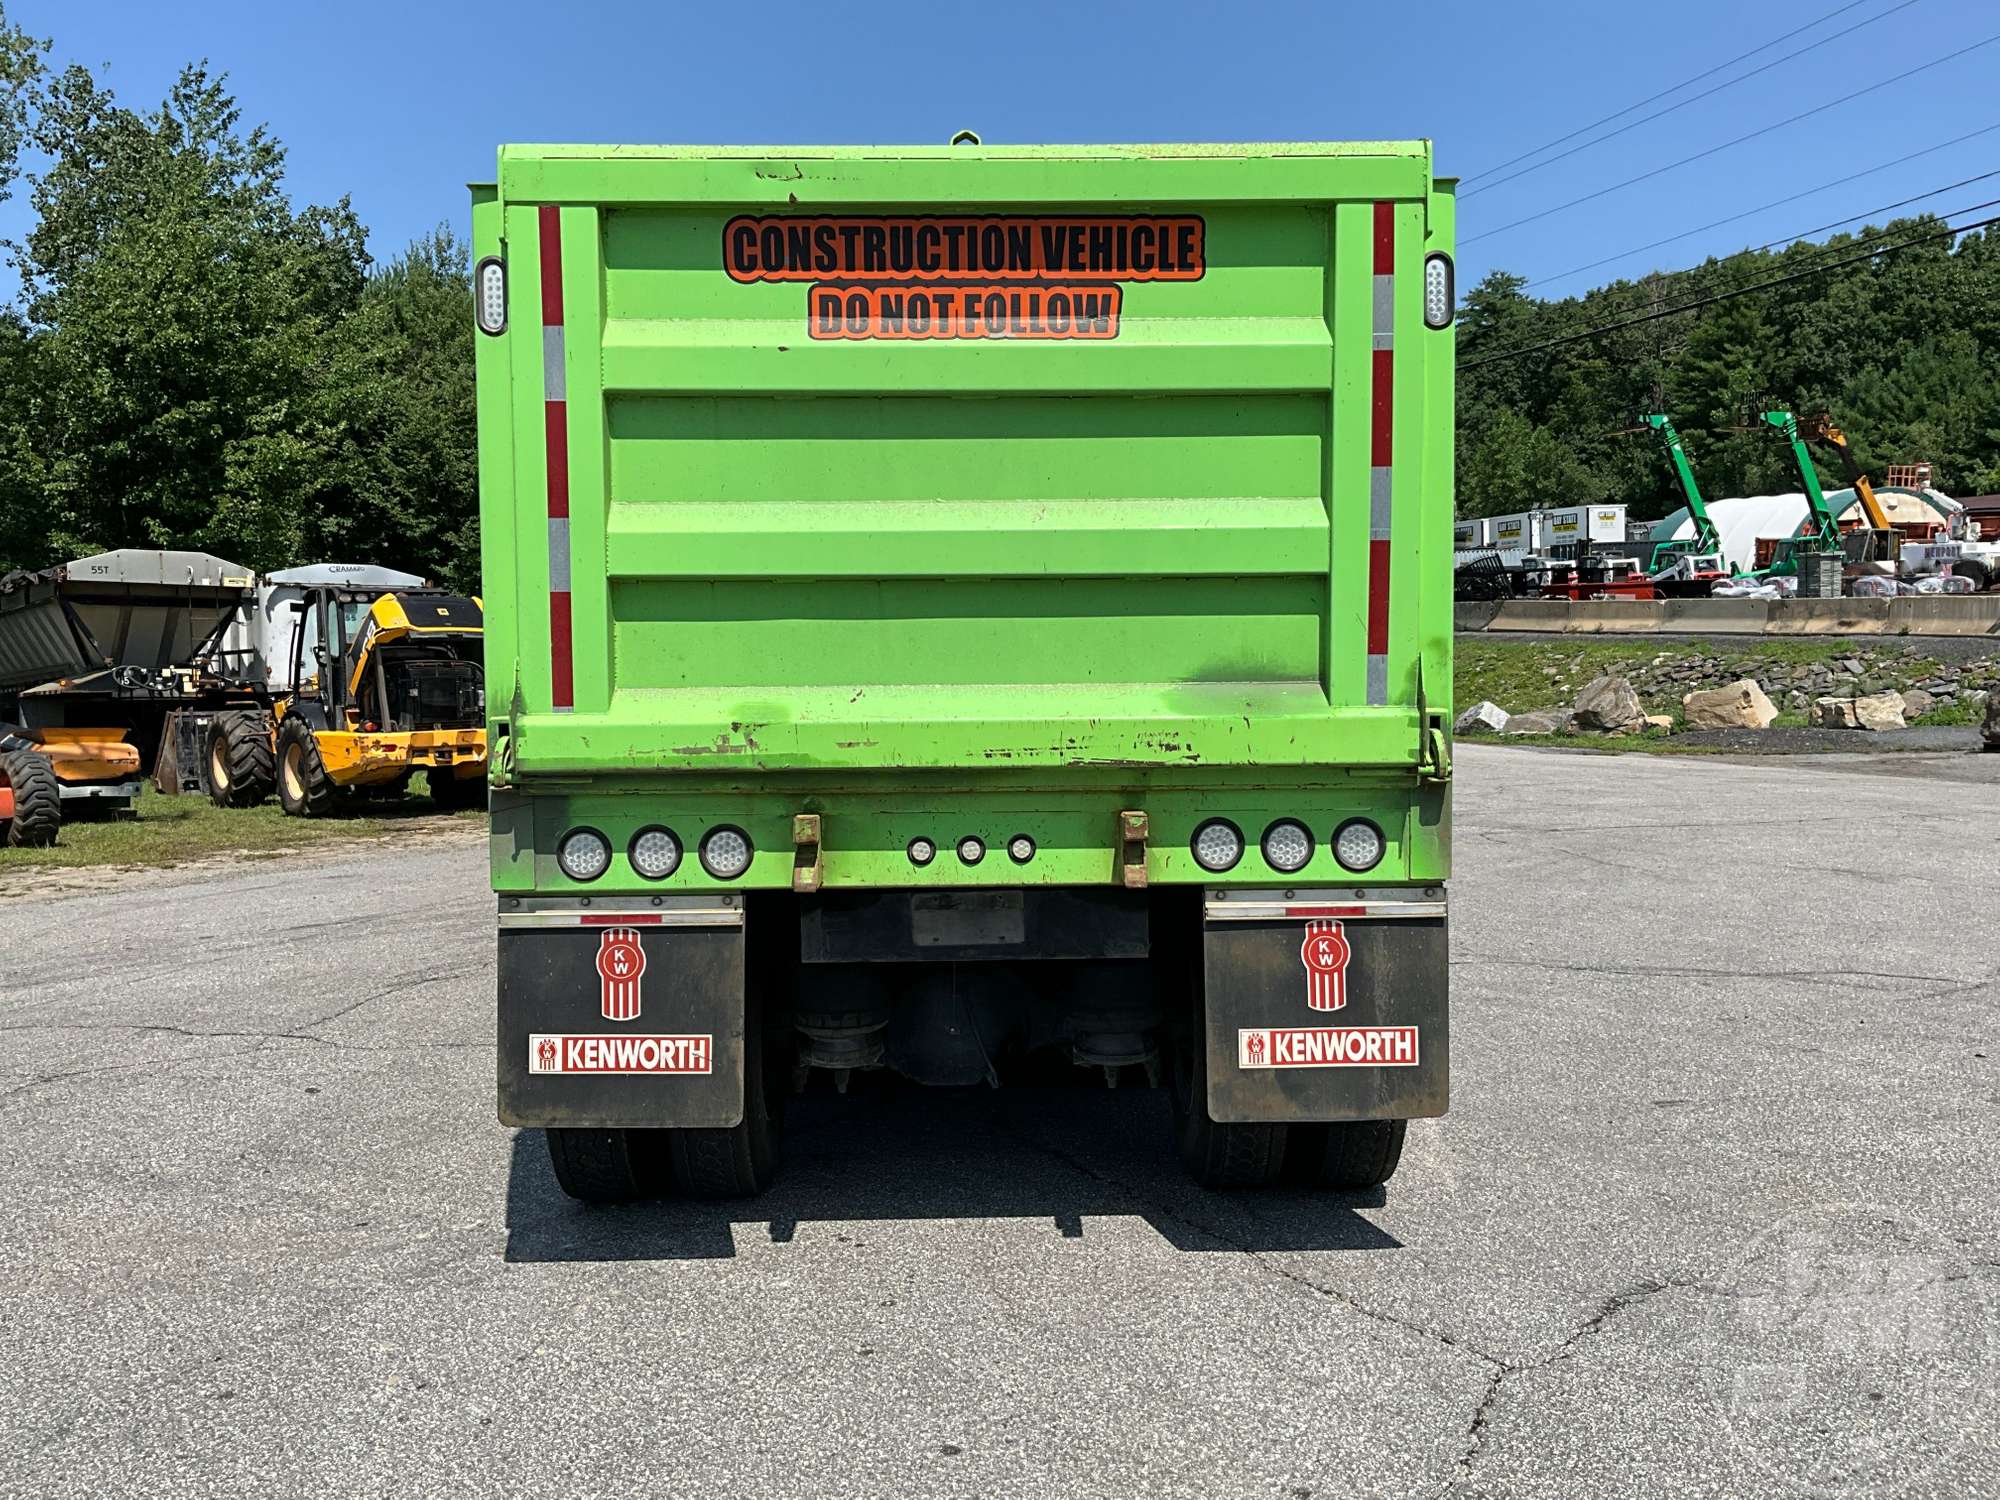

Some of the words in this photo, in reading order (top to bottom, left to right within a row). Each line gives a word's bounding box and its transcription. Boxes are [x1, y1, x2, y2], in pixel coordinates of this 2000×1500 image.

[732, 224, 1032, 273] CONSTRUCTION
[1040, 224, 1196, 273] VEHICLE
[818, 292, 870, 336] DO
[880, 292, 955, 336] NOT
[964, 292, 1114, 336] FOLLOW
[91, 565, 110, 575] 55T
[1318, 940, 1330, 953] K
[614, 949, 625, 961] K
[1318, 953, 1334, 966] W
[613, 962, 630, 975] W
[1275, 1030, 1412, 1062] KENWORTH
[567, 1039, 705, 1069] KENWORTH
